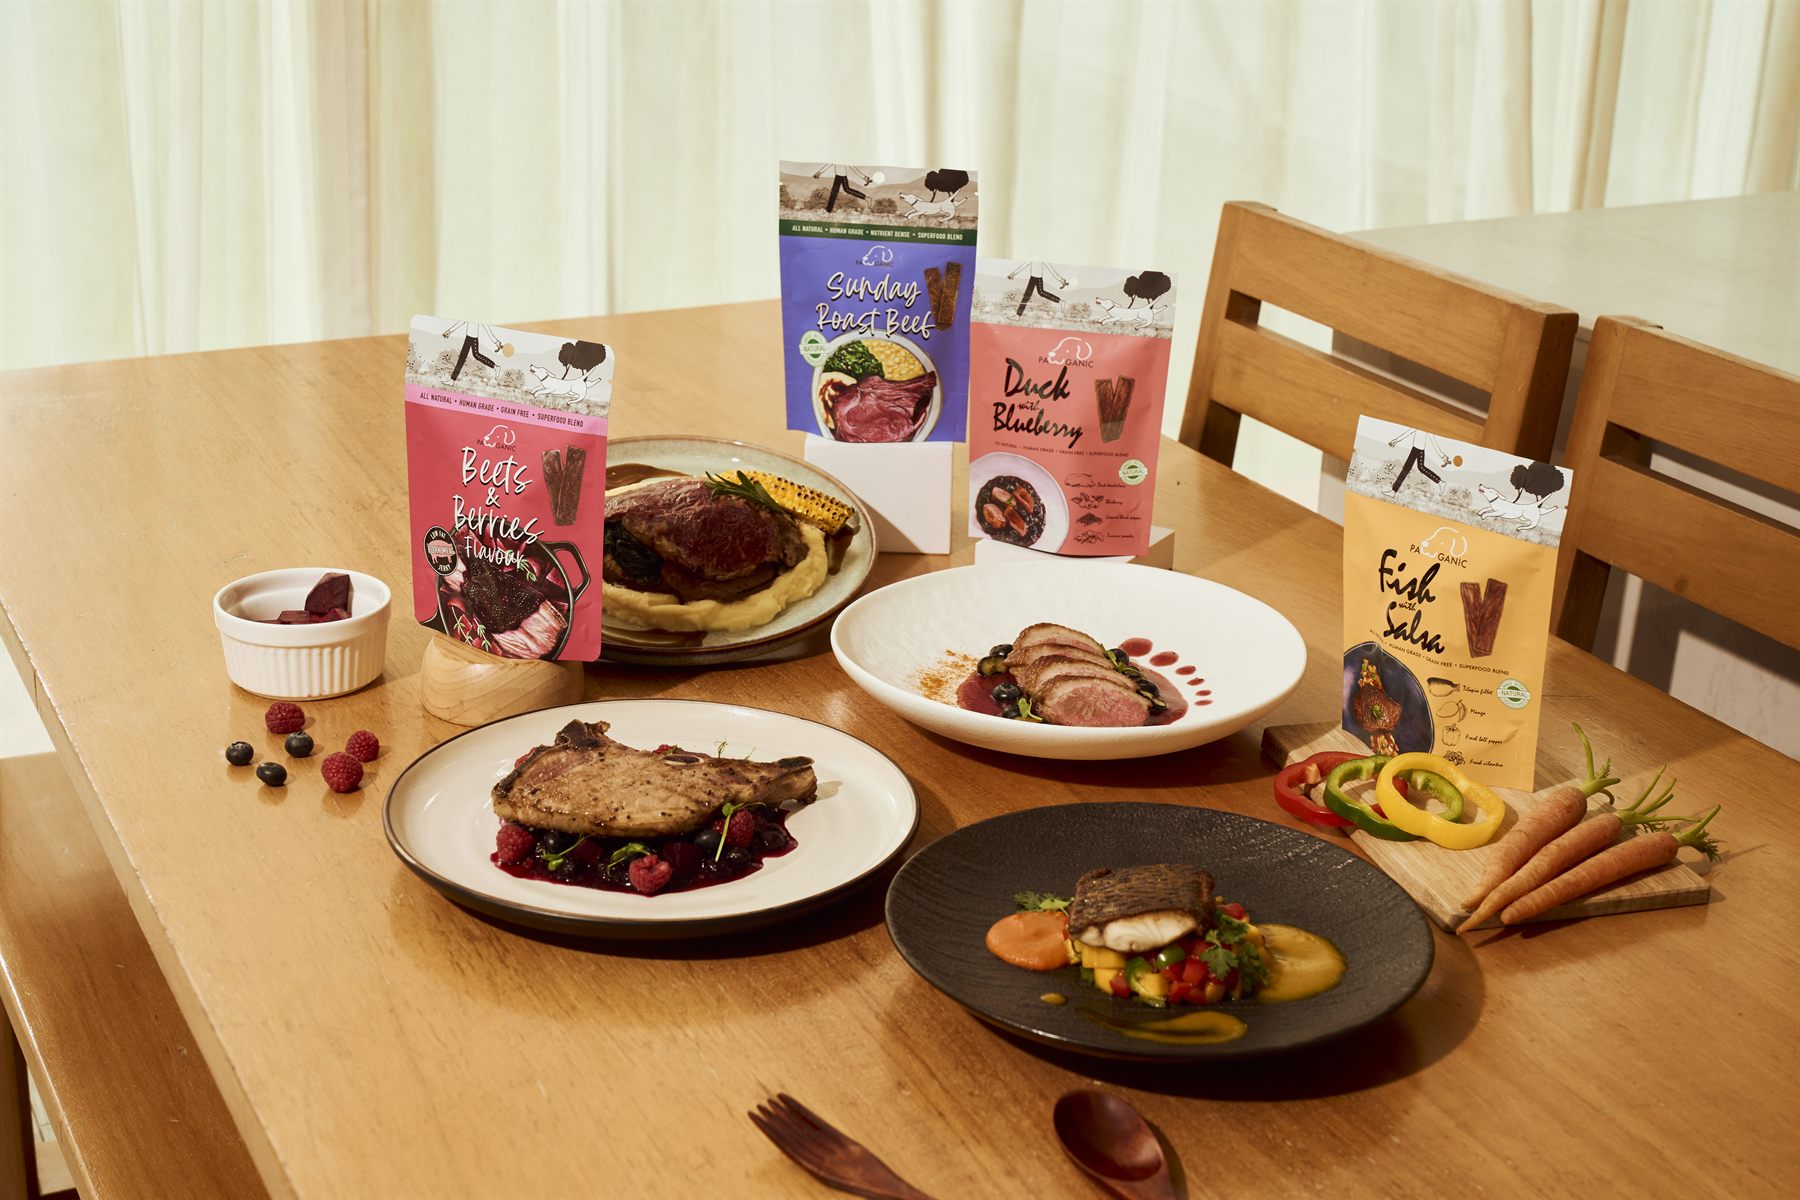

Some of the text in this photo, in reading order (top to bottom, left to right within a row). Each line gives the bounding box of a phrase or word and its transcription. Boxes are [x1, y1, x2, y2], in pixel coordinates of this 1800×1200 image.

[792, 224, 801, 232] ALL
[802, 225, 823, 233] NATURAL
[847, 228, 864, 236] GRADE
[870, 229, 894, 237] NUTRIENT
[917, 231, 946, 240] SUPERFOOD
[946, 233, 963, 241] BLEND
[826, 271, 922, 308] Sunday
[815, 302, 936, 340] Roast Beef
[1004, 357, 1070, 402] Duck
[420, 392, 584, 427] ALL NATURAL HUMAN GRADE GRAIN FREE SUPERFOOD BLEND
[1017, 400, 1040, 411] with
[992, 402, 1084, 449] Blueberry
[461, 446, 533, 495] Beets
[485, 487, 501, 508] &
[452, 494, 544, 544] Berries
[464, 535, 525, 569] Flavour
[1378, 548, 1441, 604] Fish
[1398, 601, 1417, 612] with
[1383, 601, 1445, 655] Salsa
[1388, 642, 1509, 676] HUMAN GRADE GRAIN FREE SUPERFOOD BLEND
[1501, 690, 1526, 698] NATURAL
[1470, 708, 1486, 717] Mango
